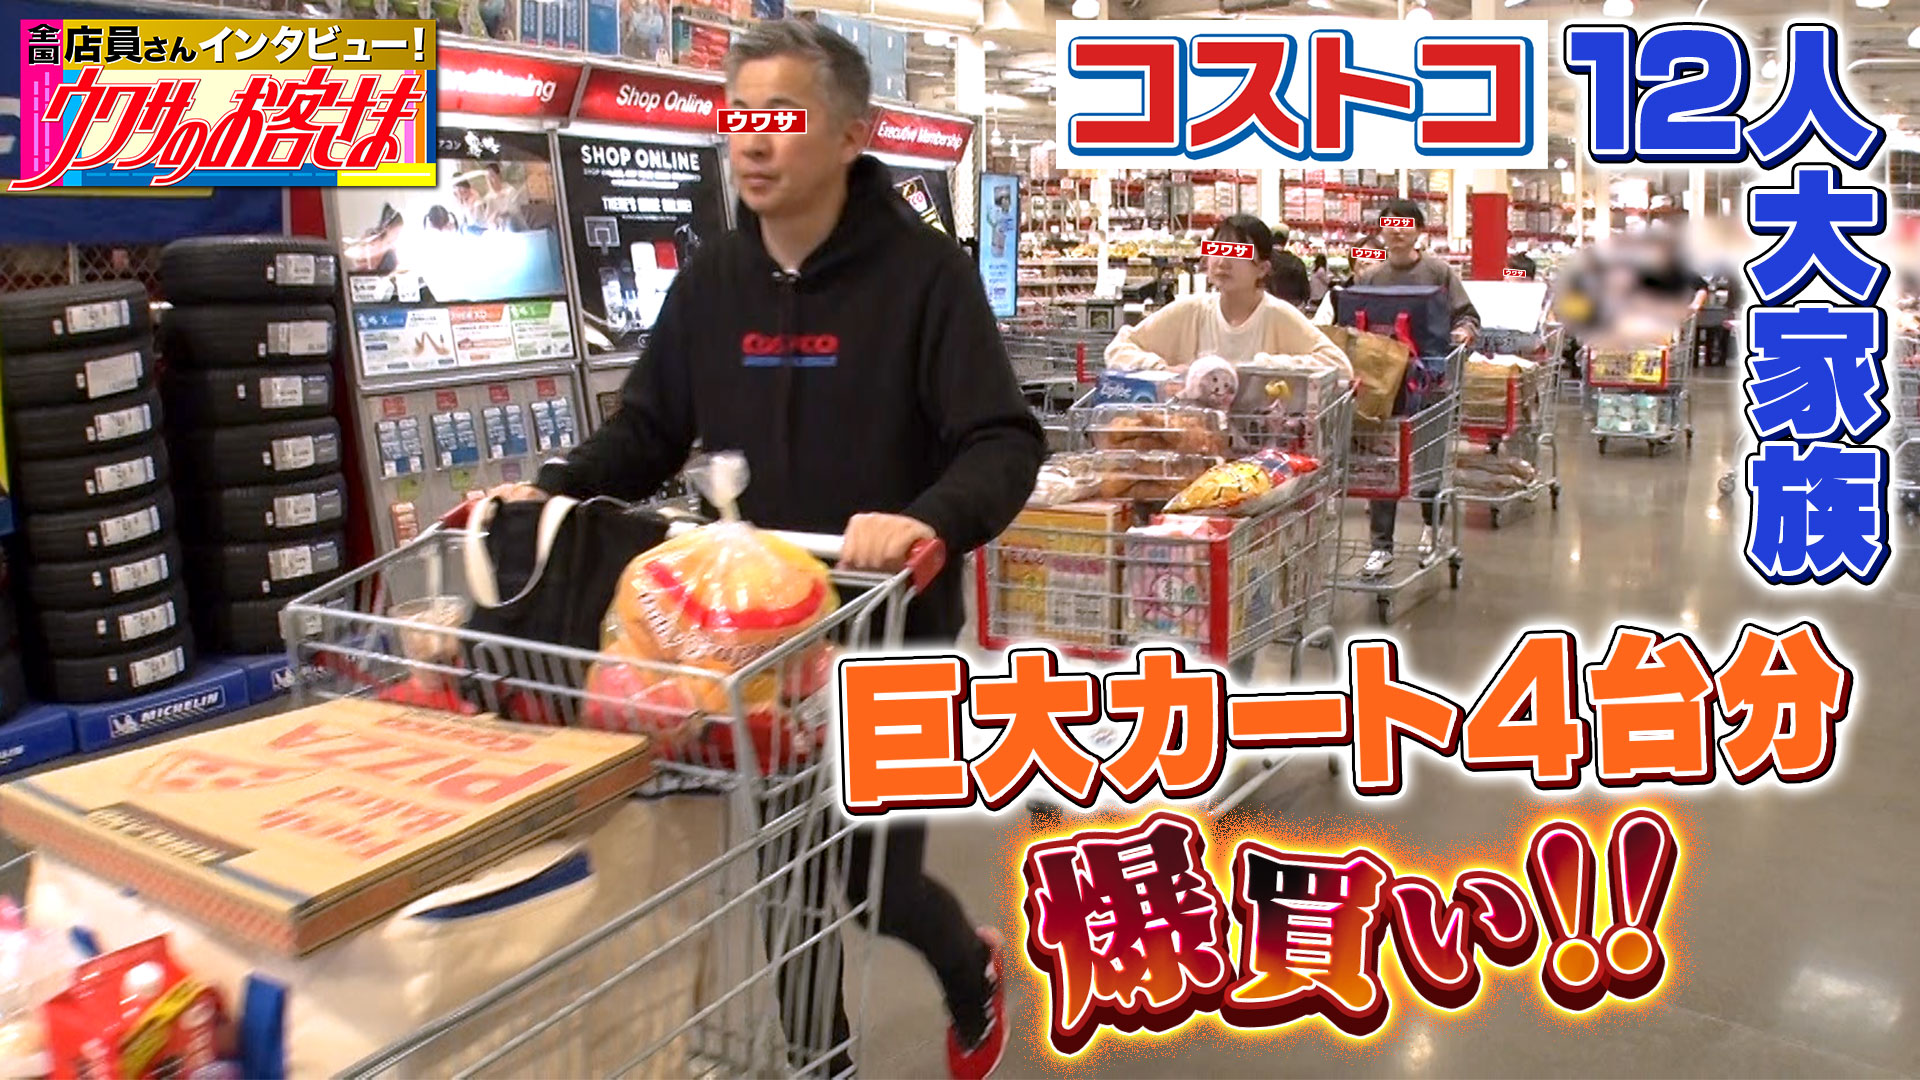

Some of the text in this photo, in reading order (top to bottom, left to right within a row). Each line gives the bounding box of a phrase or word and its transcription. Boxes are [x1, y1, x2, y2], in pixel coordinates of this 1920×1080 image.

[616, 84, 713, 116] Shop Online
[877, 121, 919, 143] Executive
[581, 144, 700, 171] SHOP ONLINE
[140, 692, 219, 723] MICHELIN
[268, 721, 571, 803] PIZZA
